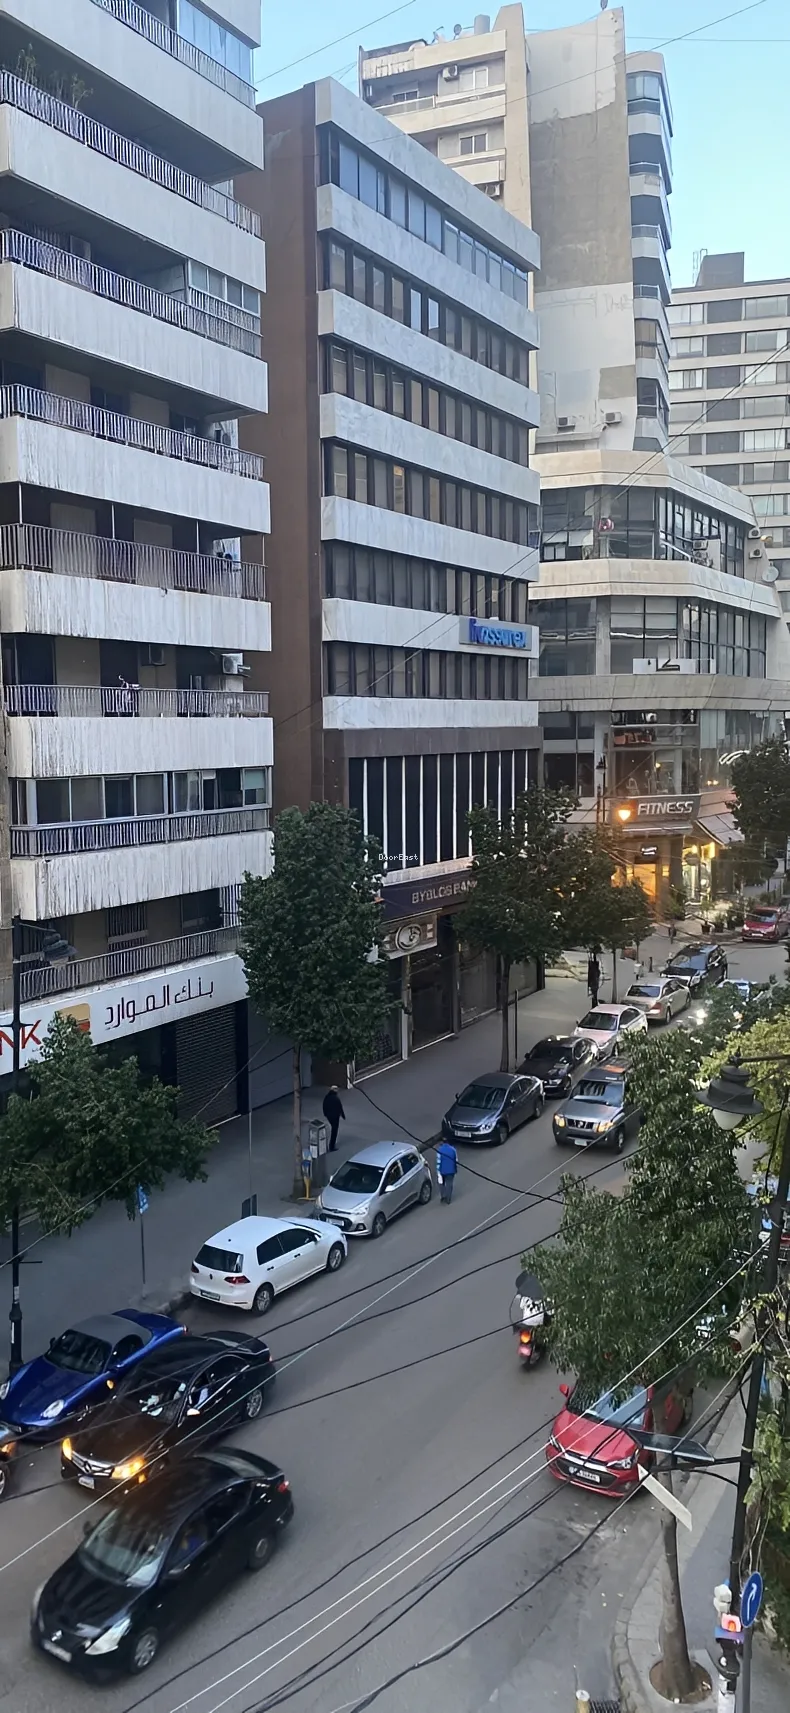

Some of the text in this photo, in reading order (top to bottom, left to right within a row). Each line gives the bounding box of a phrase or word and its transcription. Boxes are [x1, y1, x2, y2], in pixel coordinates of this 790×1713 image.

[637, 801, 694, 816] FITNESS
[104, 976, 214, 1029] بنك الموارد
